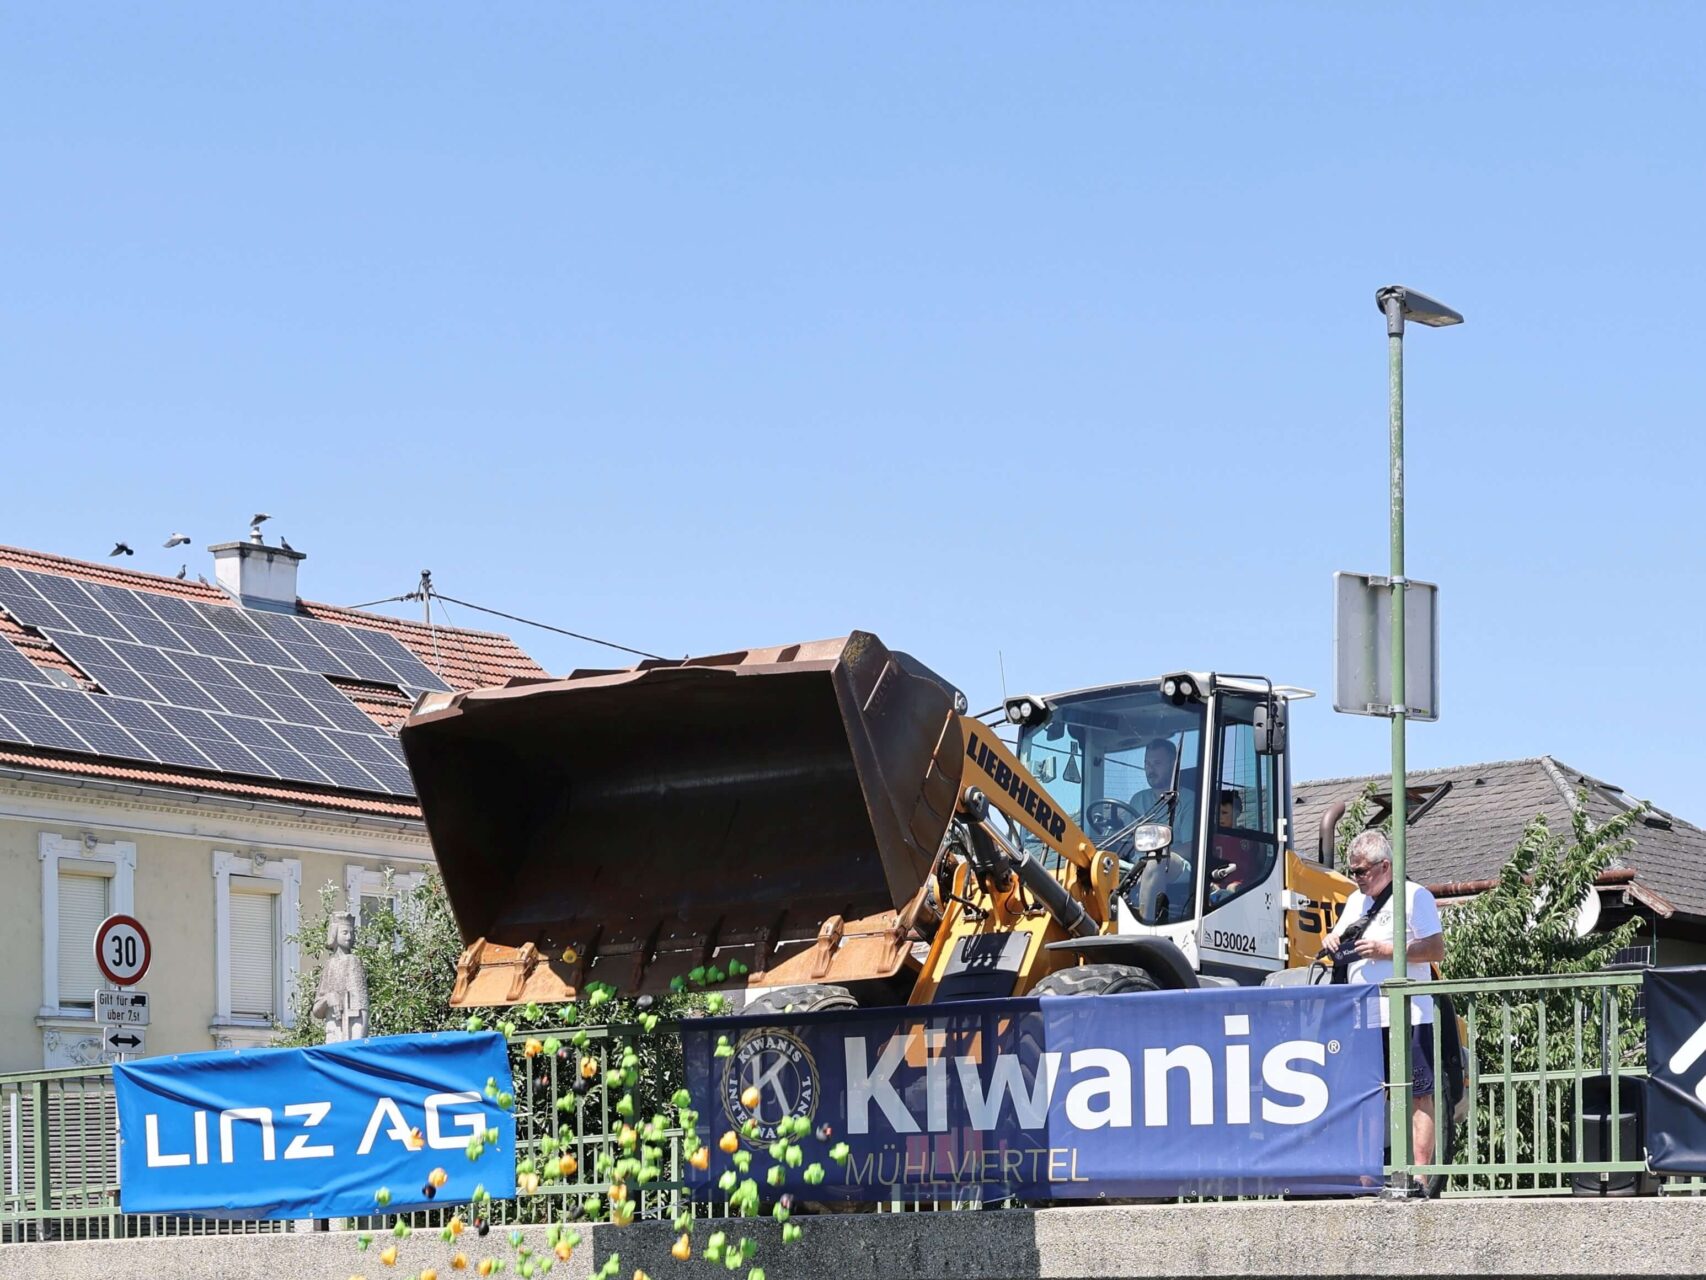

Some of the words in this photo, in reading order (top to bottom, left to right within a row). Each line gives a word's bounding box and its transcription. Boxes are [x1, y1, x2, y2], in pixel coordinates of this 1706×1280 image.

[966, 731, 1067, 843] LIEBHERR
[111, 935, 137, 968] 30
[1214, 929, 1257, 953] D30024
[99, 993, 113, 1006] Gilt
[116, 995, 129, 1006] für
[107, 1009, 125, 1021] über
[738, 1037, 802, 1063] KIWANIS
[356, 1091, 487, 1155] AG
[845, 1143, 1089, 1186] MÜHLVIERTEL
